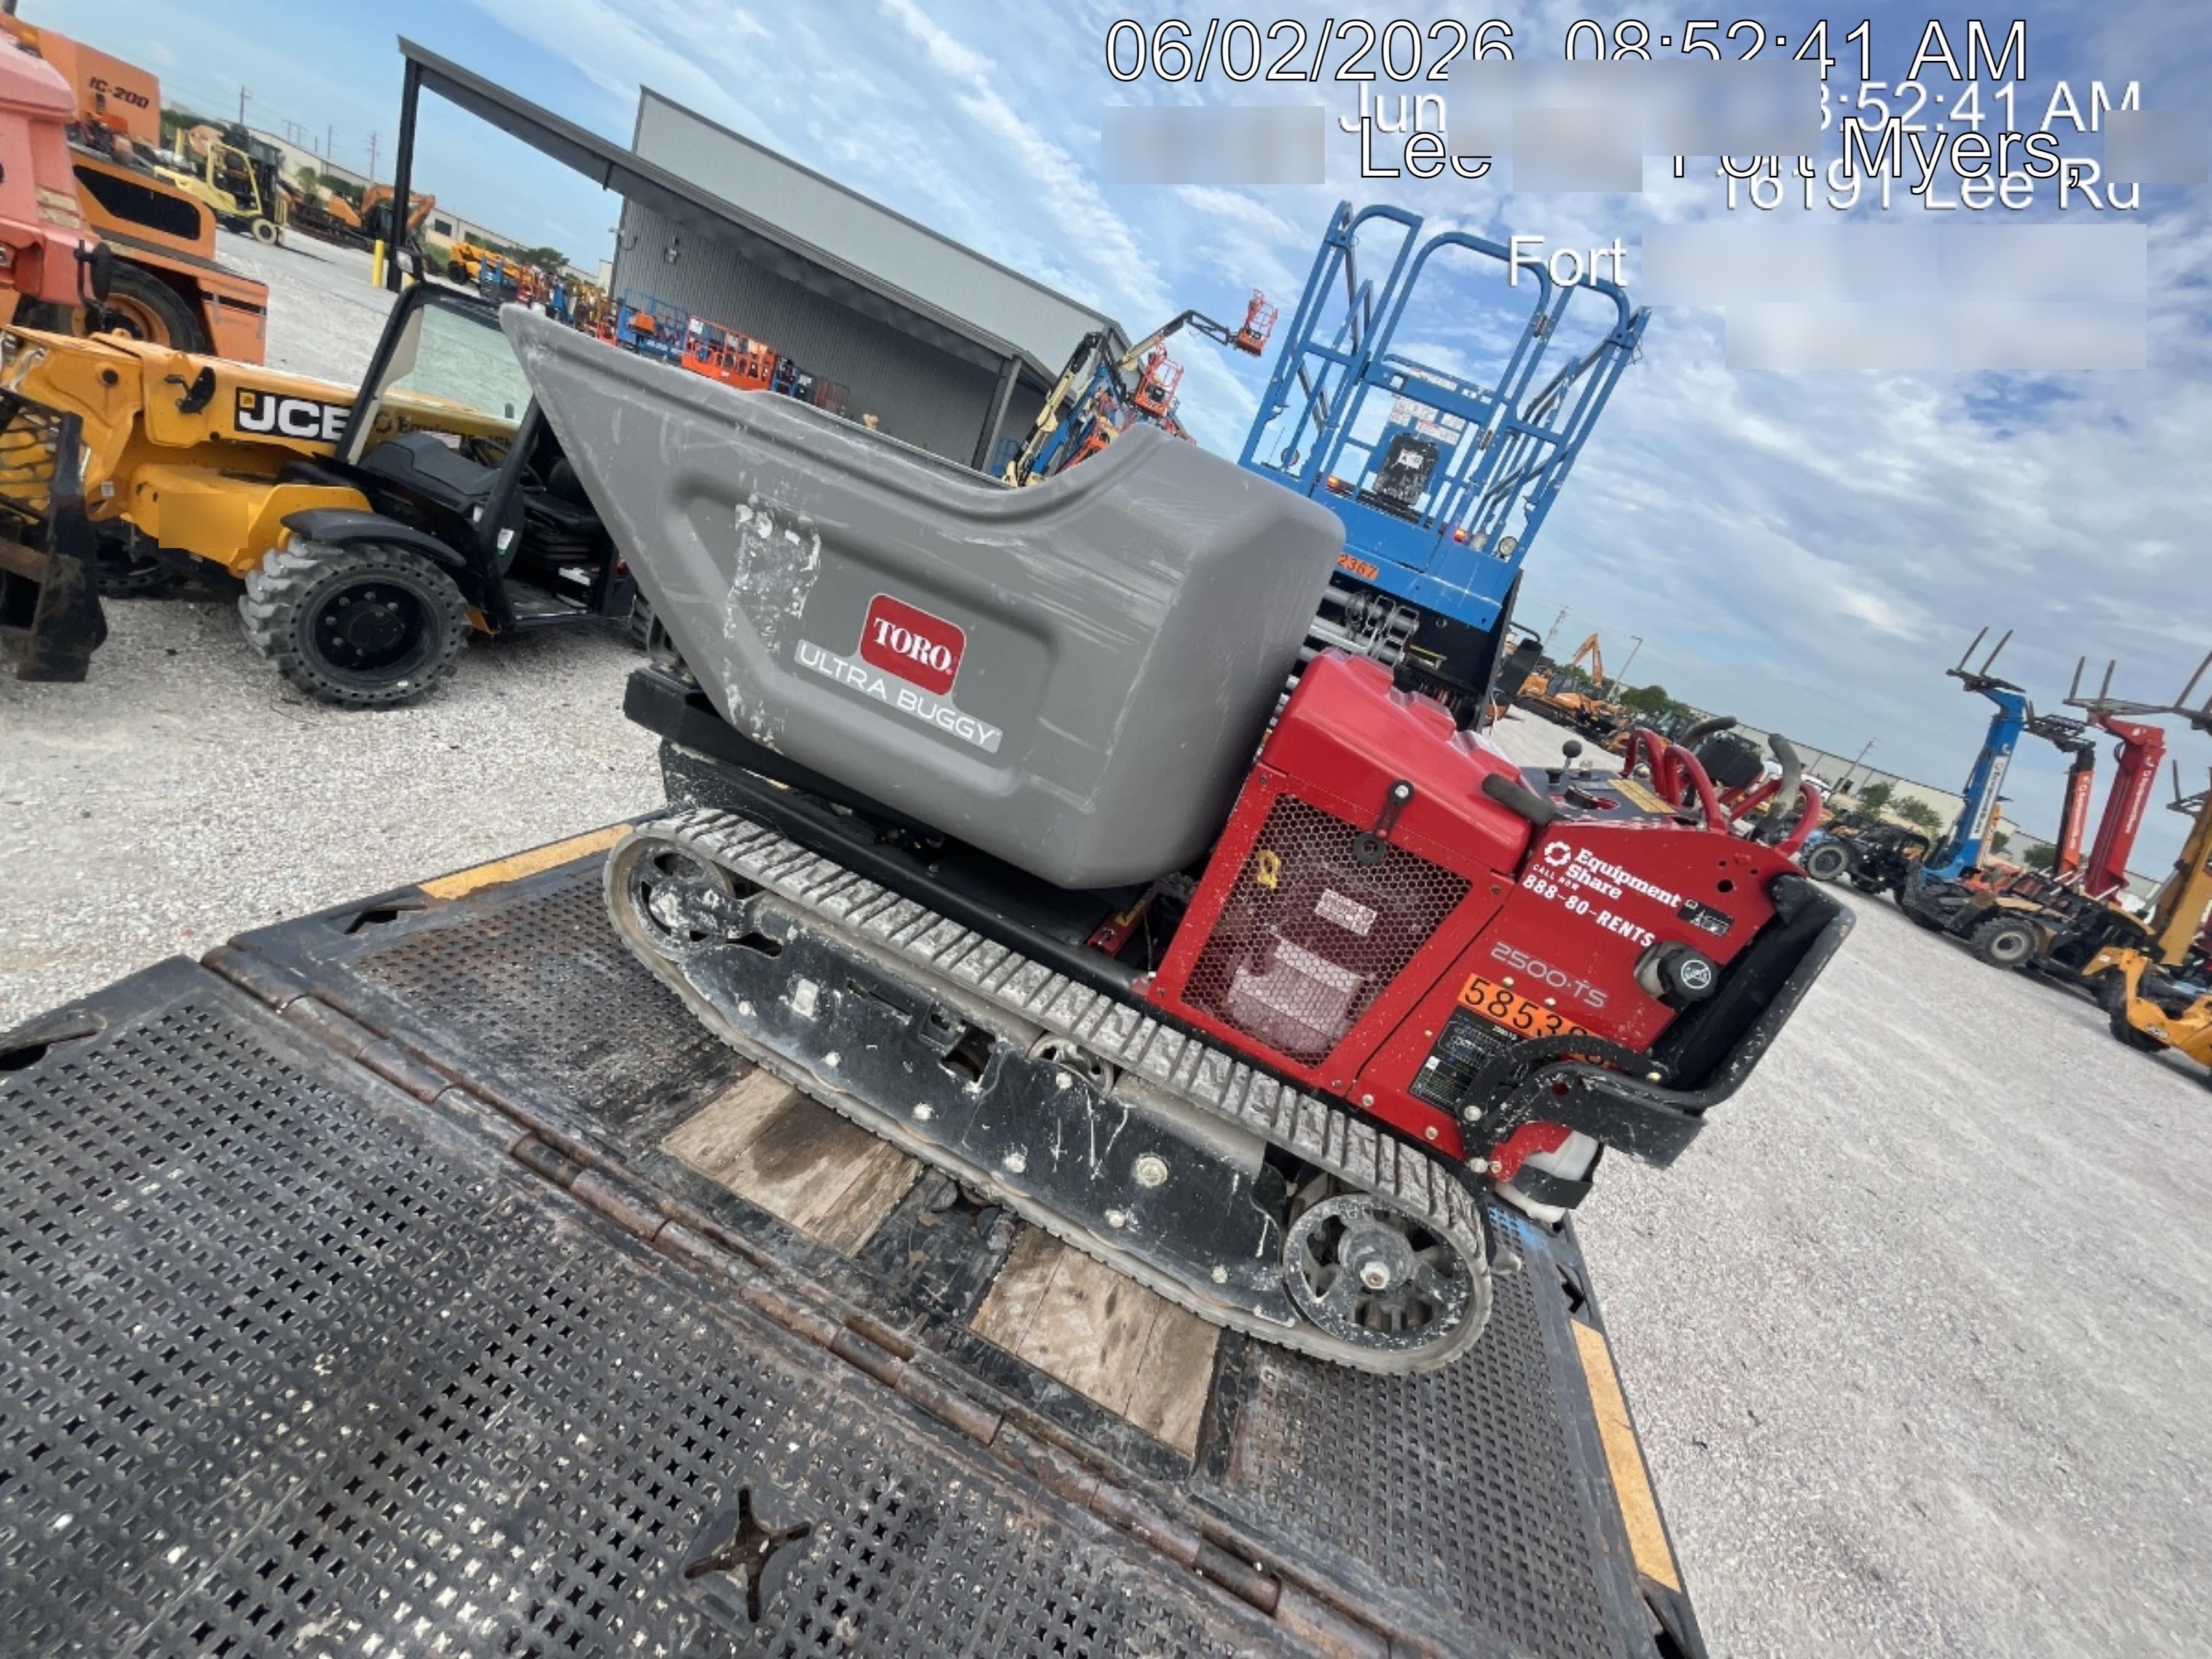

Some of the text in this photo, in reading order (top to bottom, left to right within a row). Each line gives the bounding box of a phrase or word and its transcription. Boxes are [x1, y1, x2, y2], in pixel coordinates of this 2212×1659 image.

[90, 77, 150, 109] IC-200
[873, 617, 952, 673] TORO
[799, 643, 996, 745] ULTRA BUGGY
[1532, 863, 1555, 880] CALL
[1566, 863, 1623, 900] Share
[1574, 847, 1682, 908] Equipment
[1522, 874, 1656, 947] 888-80-RENTS
[1465, 977, 1604, 1066] 5853
